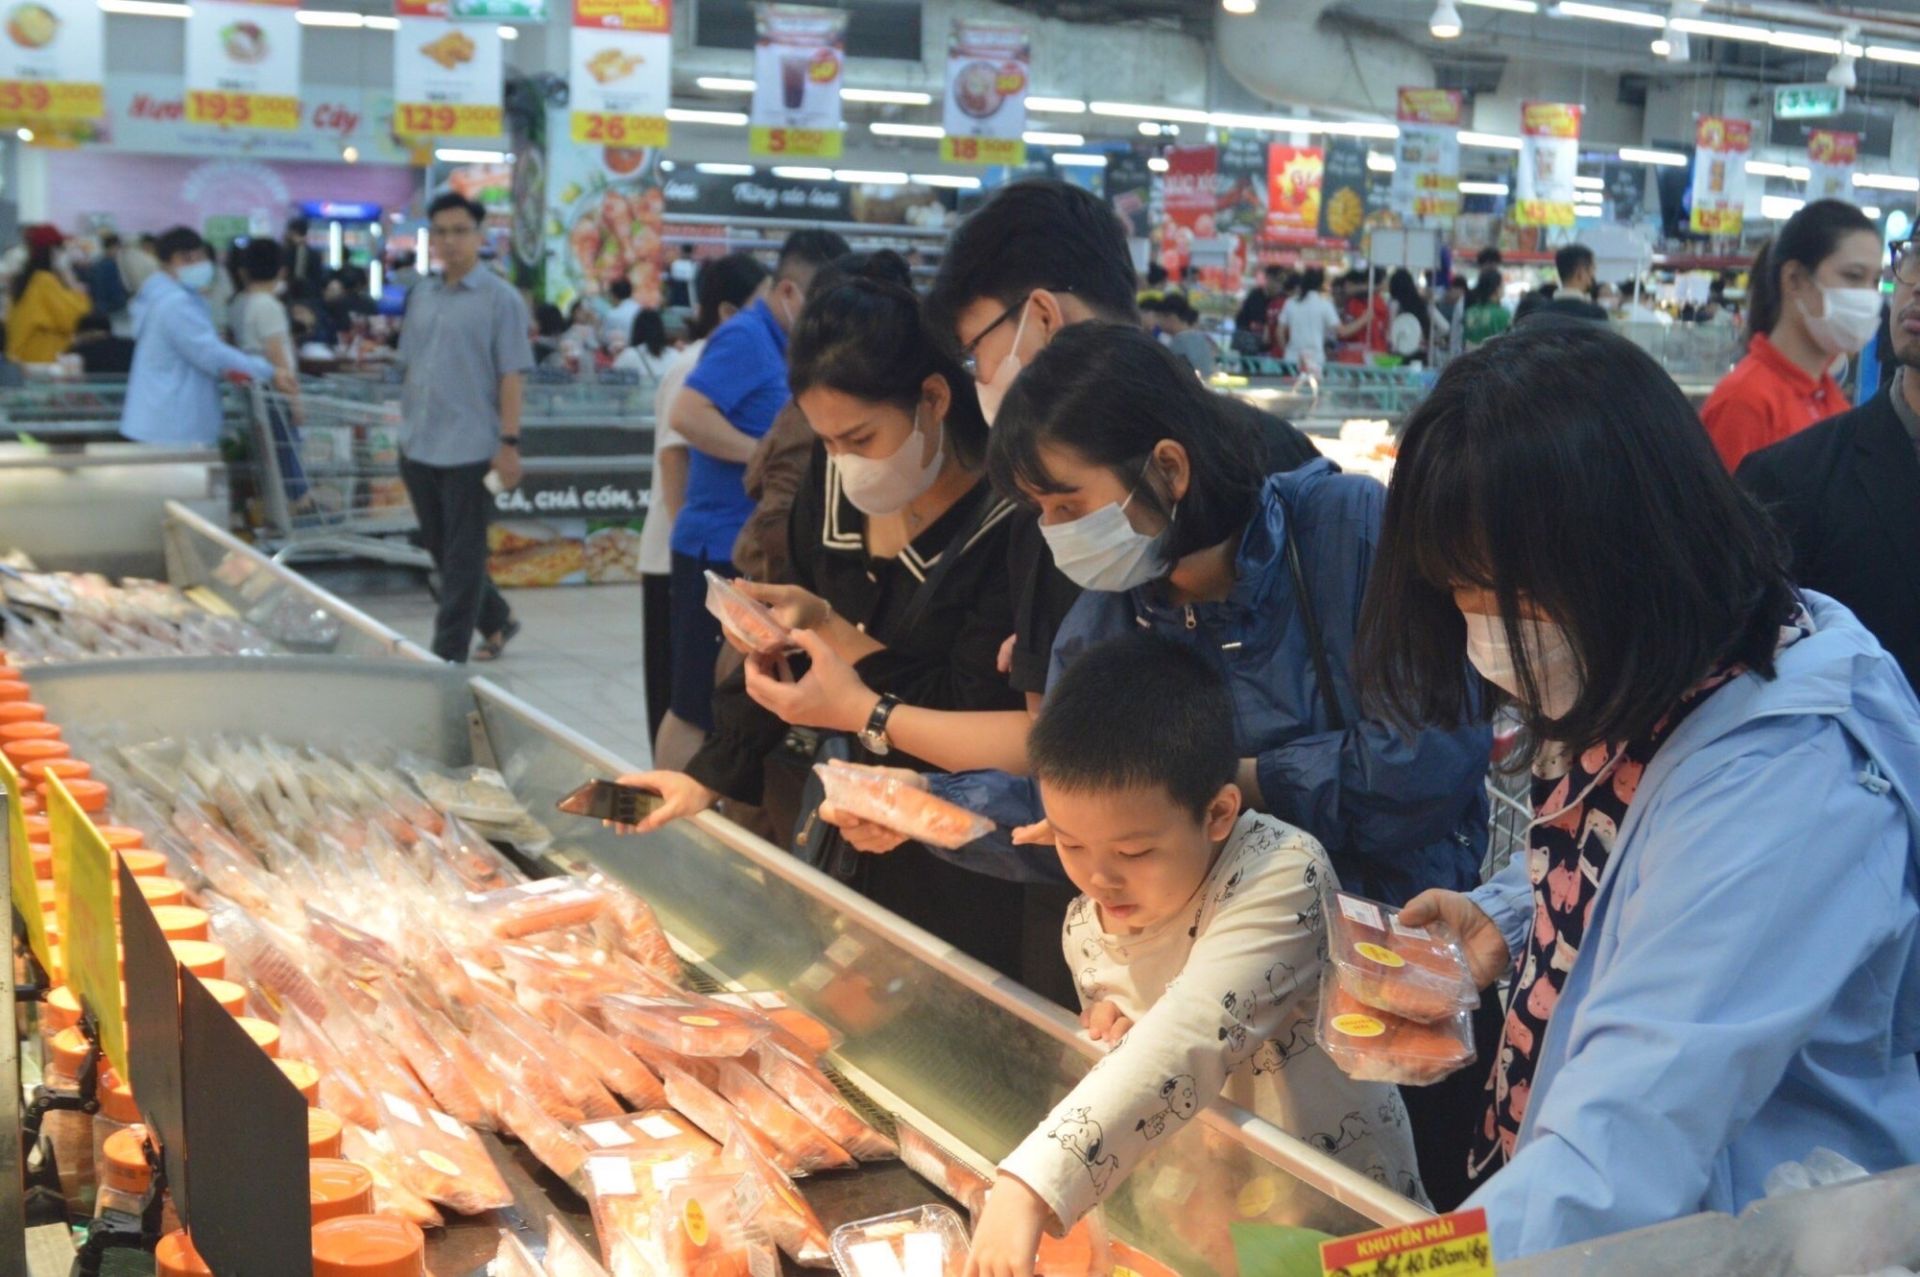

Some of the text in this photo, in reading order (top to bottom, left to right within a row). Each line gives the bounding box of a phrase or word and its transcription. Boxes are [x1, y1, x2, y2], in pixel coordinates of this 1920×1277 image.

[191, 91, 250, 122] 195
[401, 104, 456, 132] 129
[586, 113, 625, 141] 26
[768, 128, 786, 154] 5
